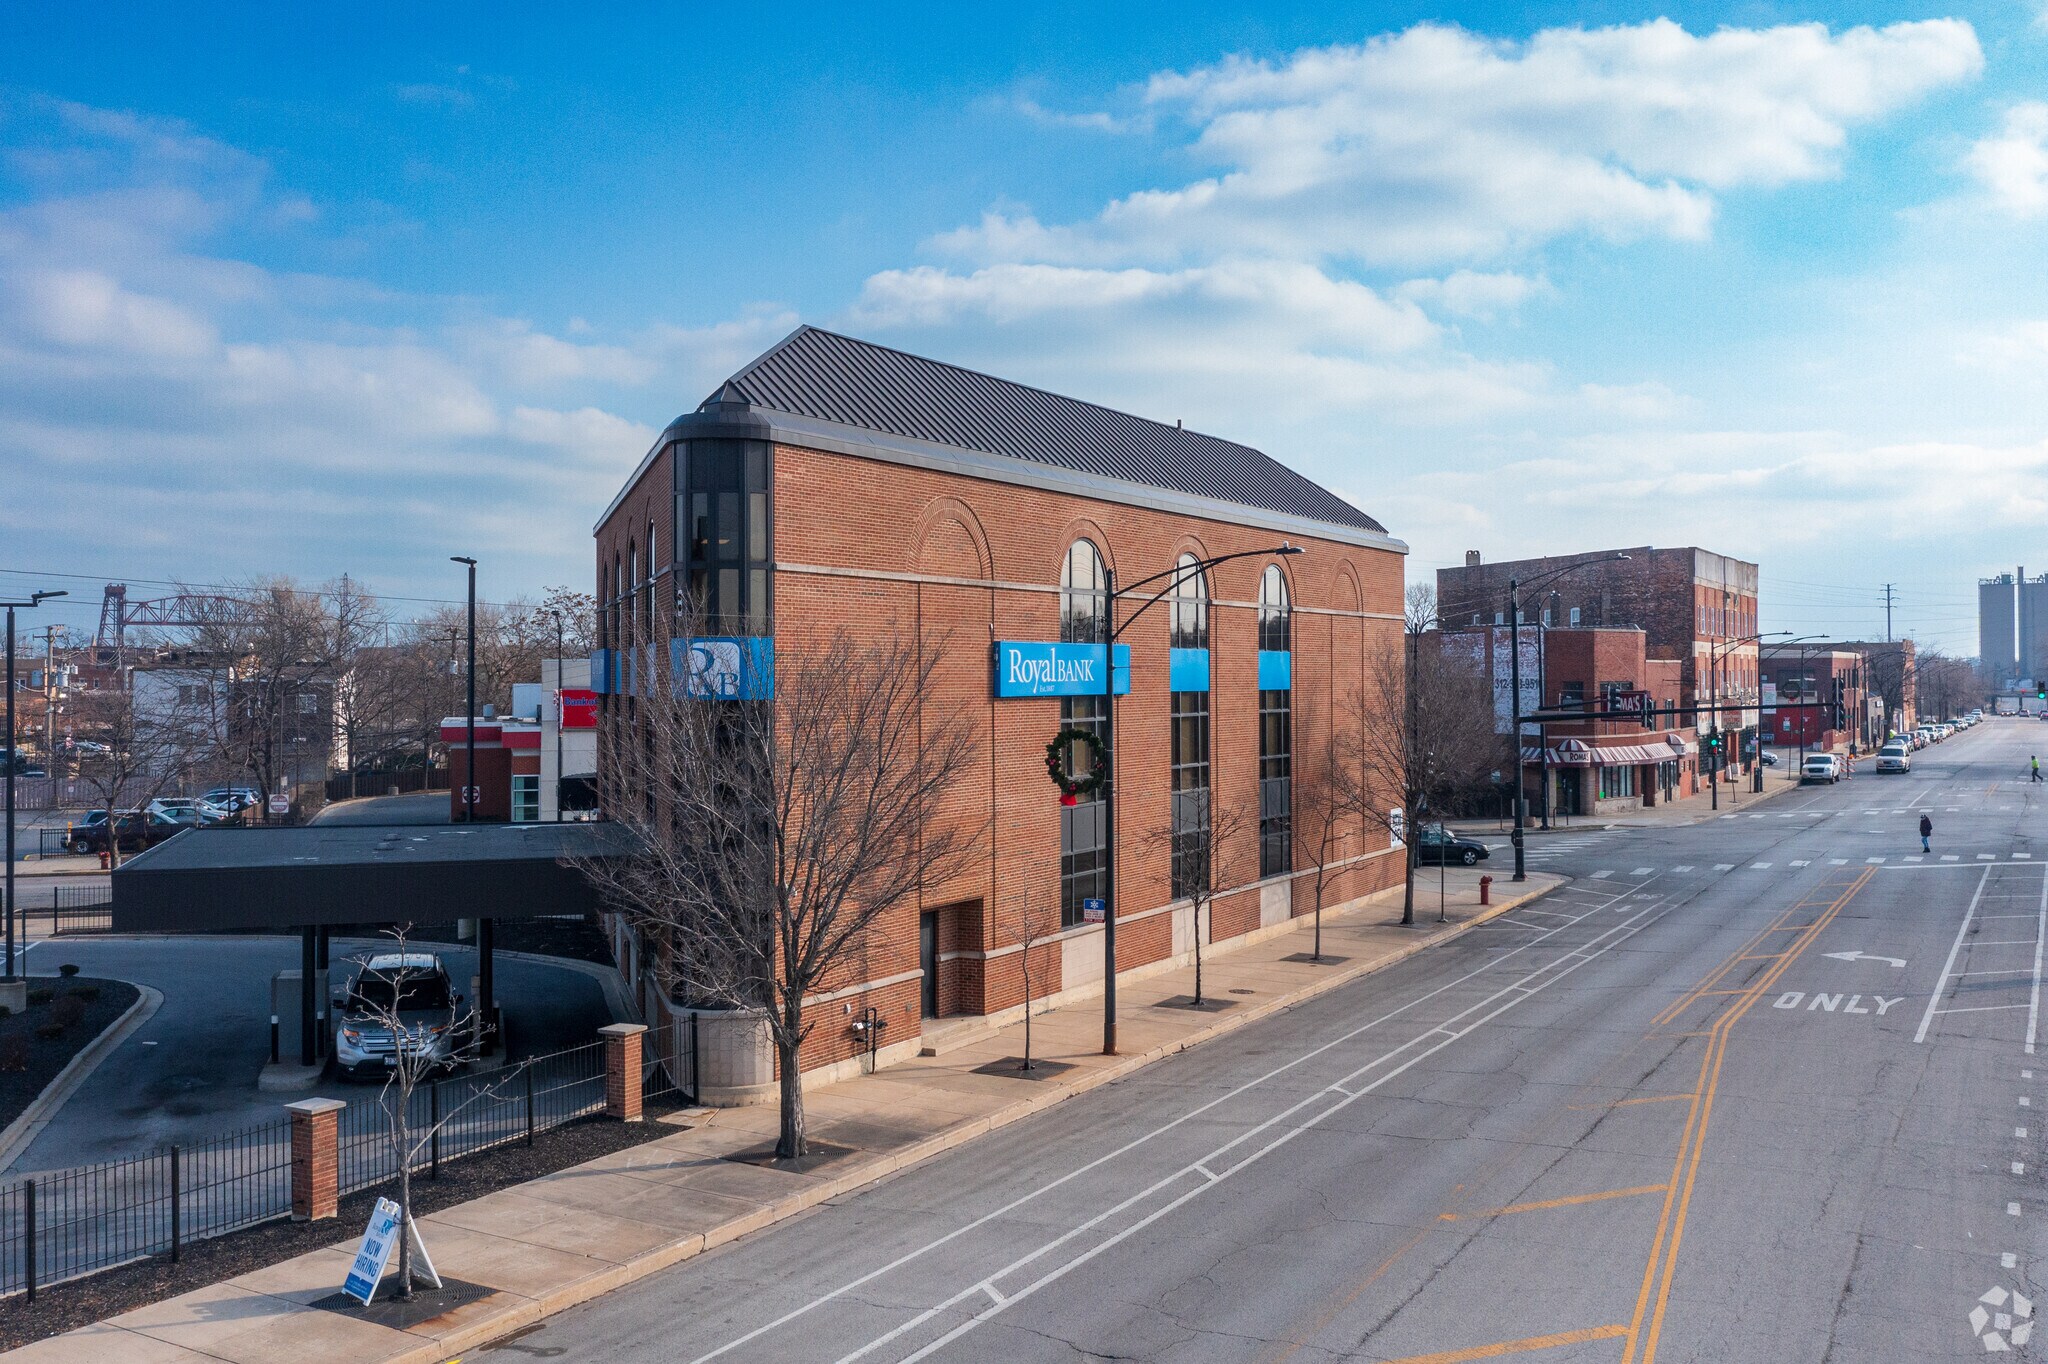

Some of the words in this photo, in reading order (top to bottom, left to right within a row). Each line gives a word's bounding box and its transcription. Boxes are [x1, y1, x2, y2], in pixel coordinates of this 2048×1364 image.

[1008, 647, 1057, 694] Royal
[1057, 659, 1095, 682] BANK
[564, 695, 587, 706] Bank
[1772, 990, 1905, 1016] ONLY
[363, 1237, 383, 1258] NOW
[354, 1253, 379, 1278] HIRING
